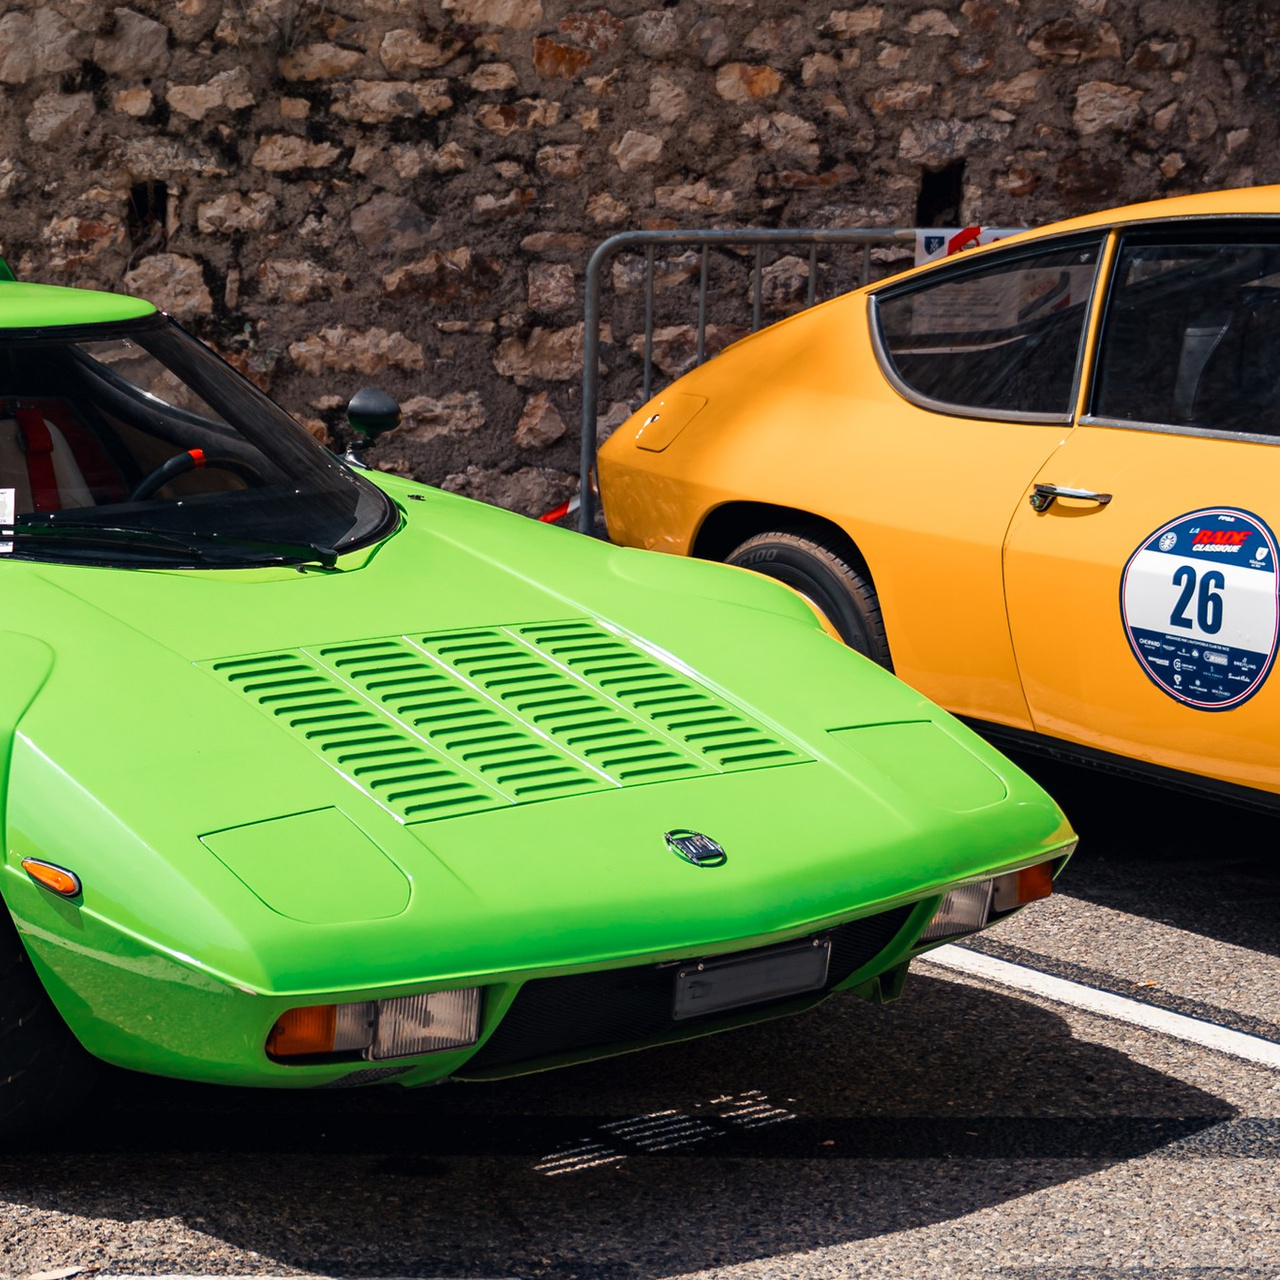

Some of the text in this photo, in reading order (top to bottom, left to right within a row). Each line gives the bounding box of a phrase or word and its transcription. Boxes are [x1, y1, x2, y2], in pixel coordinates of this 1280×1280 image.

[1192, 529, 1252, 545] RADE
[1192, 544, 1242, 553] CLASSIQUE
[1170, 565, 1225, 635] 26
